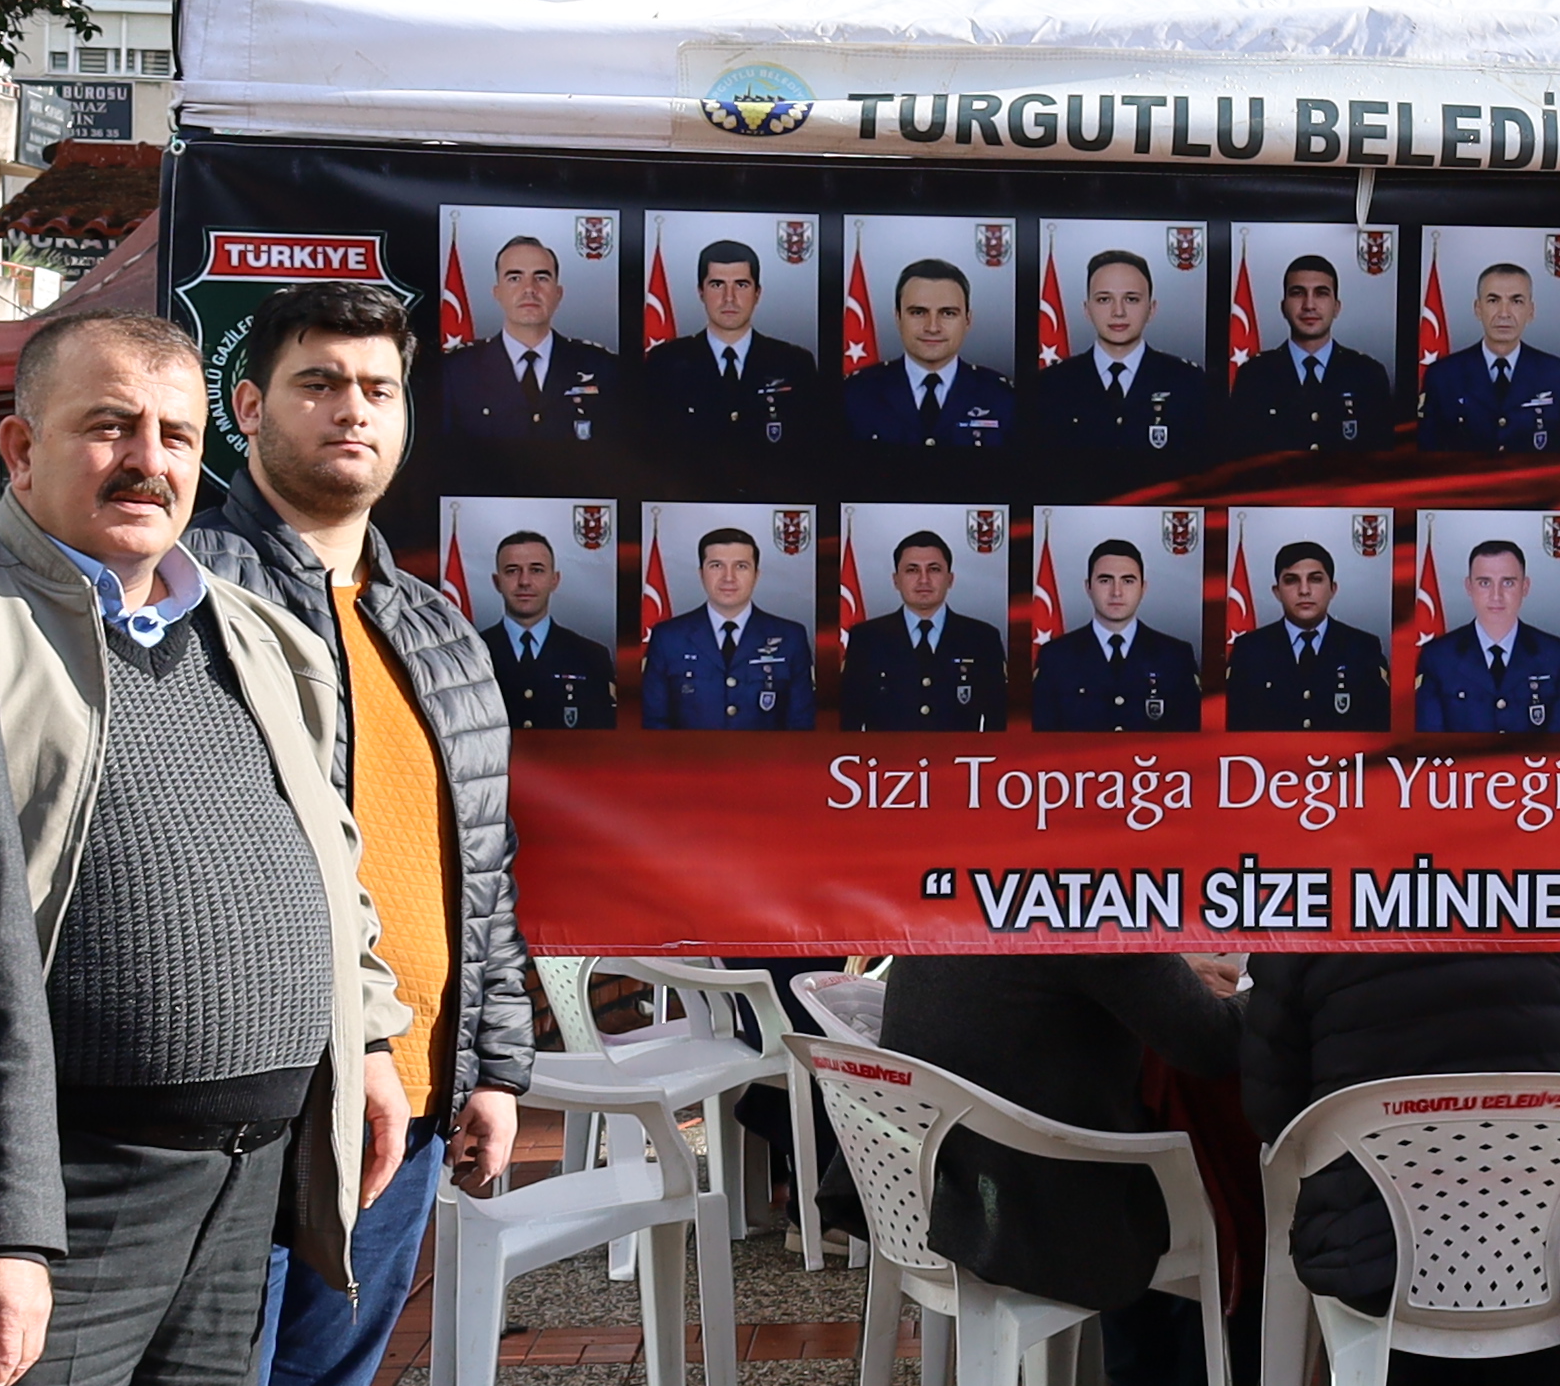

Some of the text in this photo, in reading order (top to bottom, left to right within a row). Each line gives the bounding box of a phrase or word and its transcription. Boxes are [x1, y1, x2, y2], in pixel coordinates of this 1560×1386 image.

[62, 82, 128, 101] BÜROSU
[847, 91, 1265, 161] TURGUTLU
[224, 242, 368, 270] TÜRKİYE
[225, 432, 252, 459] ARP
[826, 754, 931, 810] Sizi
[953, 754, 1193, 831] Toprağa
[1217, 753, 1366, 832] Değil
[972, 871, 1181, 930] VATAN
[1203, 856, 1331, 930] SİZE
[1383, 1096, 1479, 1116] TURGUTLU
